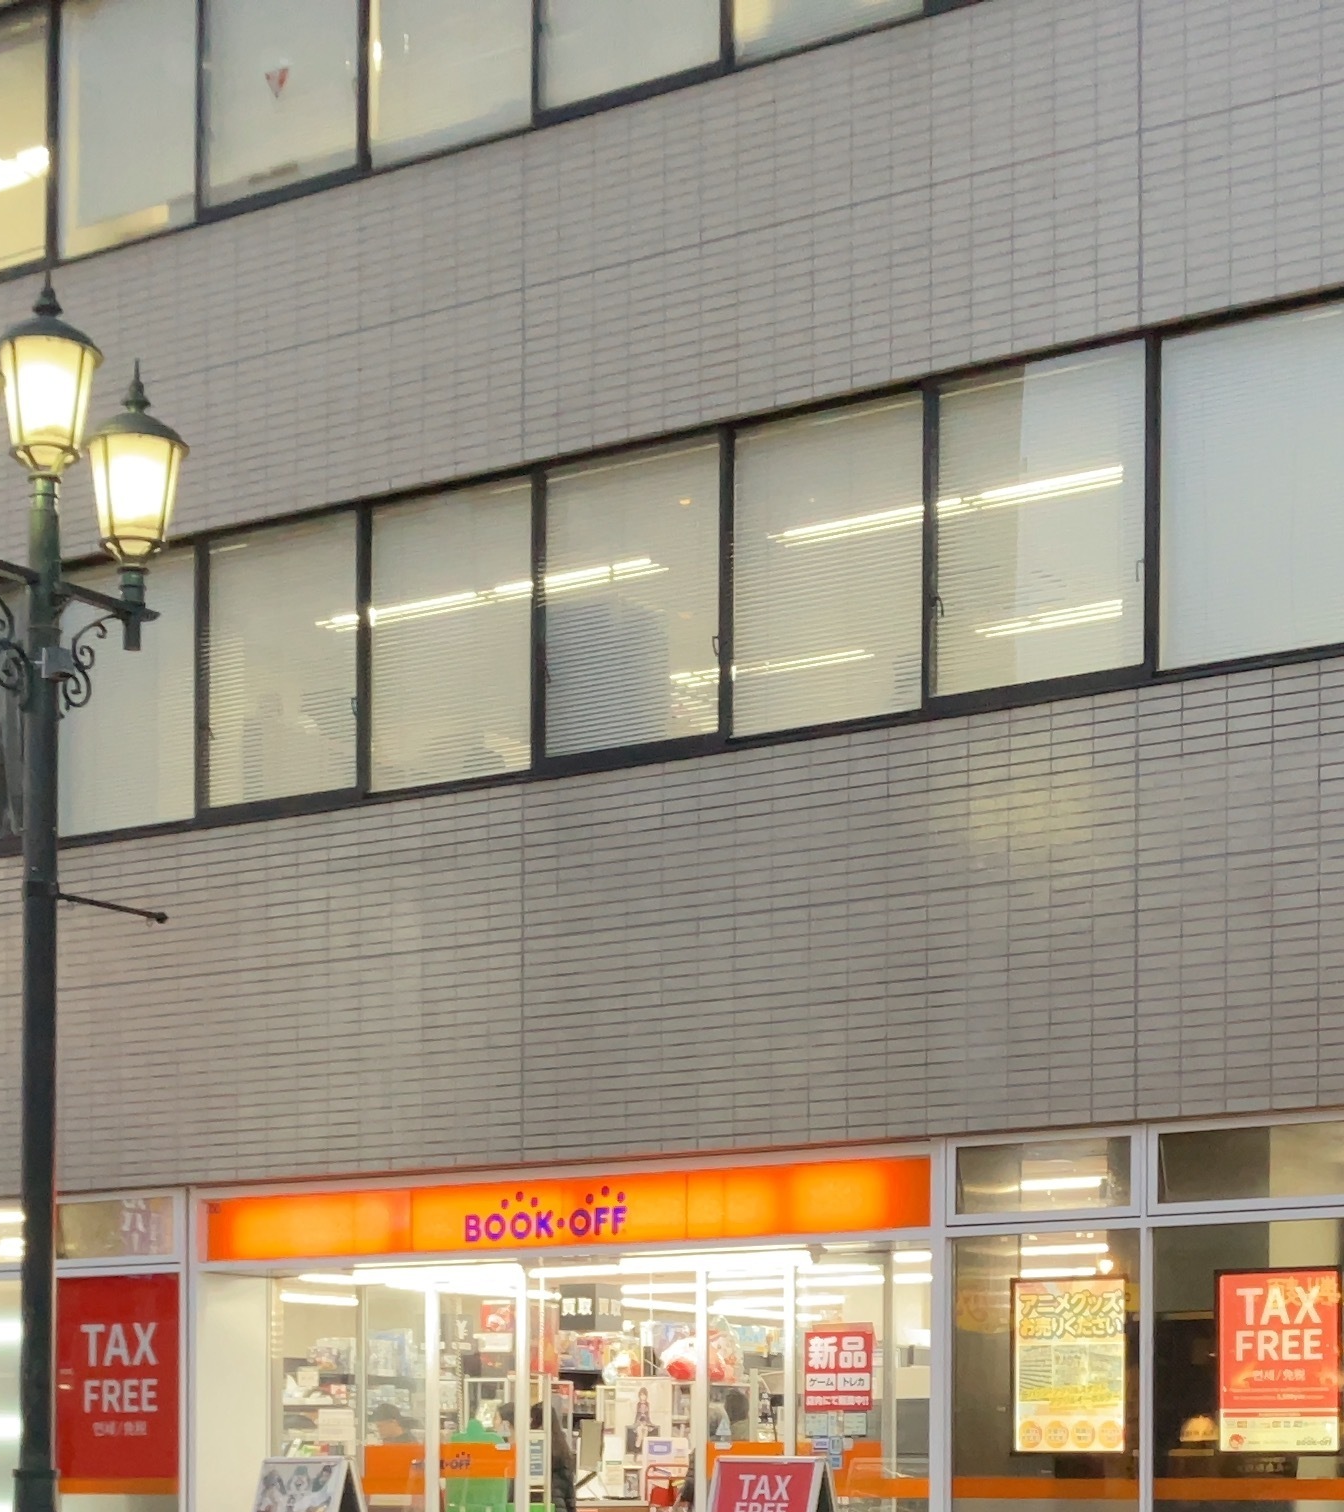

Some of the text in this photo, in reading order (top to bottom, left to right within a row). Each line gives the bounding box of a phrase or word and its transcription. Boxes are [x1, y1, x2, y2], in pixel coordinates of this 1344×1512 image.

[1018, 1290, 1123, 1317] アニメグッズ
[1236, 1286, 1323, 1326] TAX
[1018, 1315, 1125, 1338] お売りください
[80, 1322, 159, 1366] TAX
[808, 1336, 868, 1370] 新品
[1235, 1329, 1323, 1361] FREE
[83, 1378, 158, 1413] FREE
[809, 1376, 865, 1387] ゲーム トレカ
[739, 1474, 792, 1500] TAX
